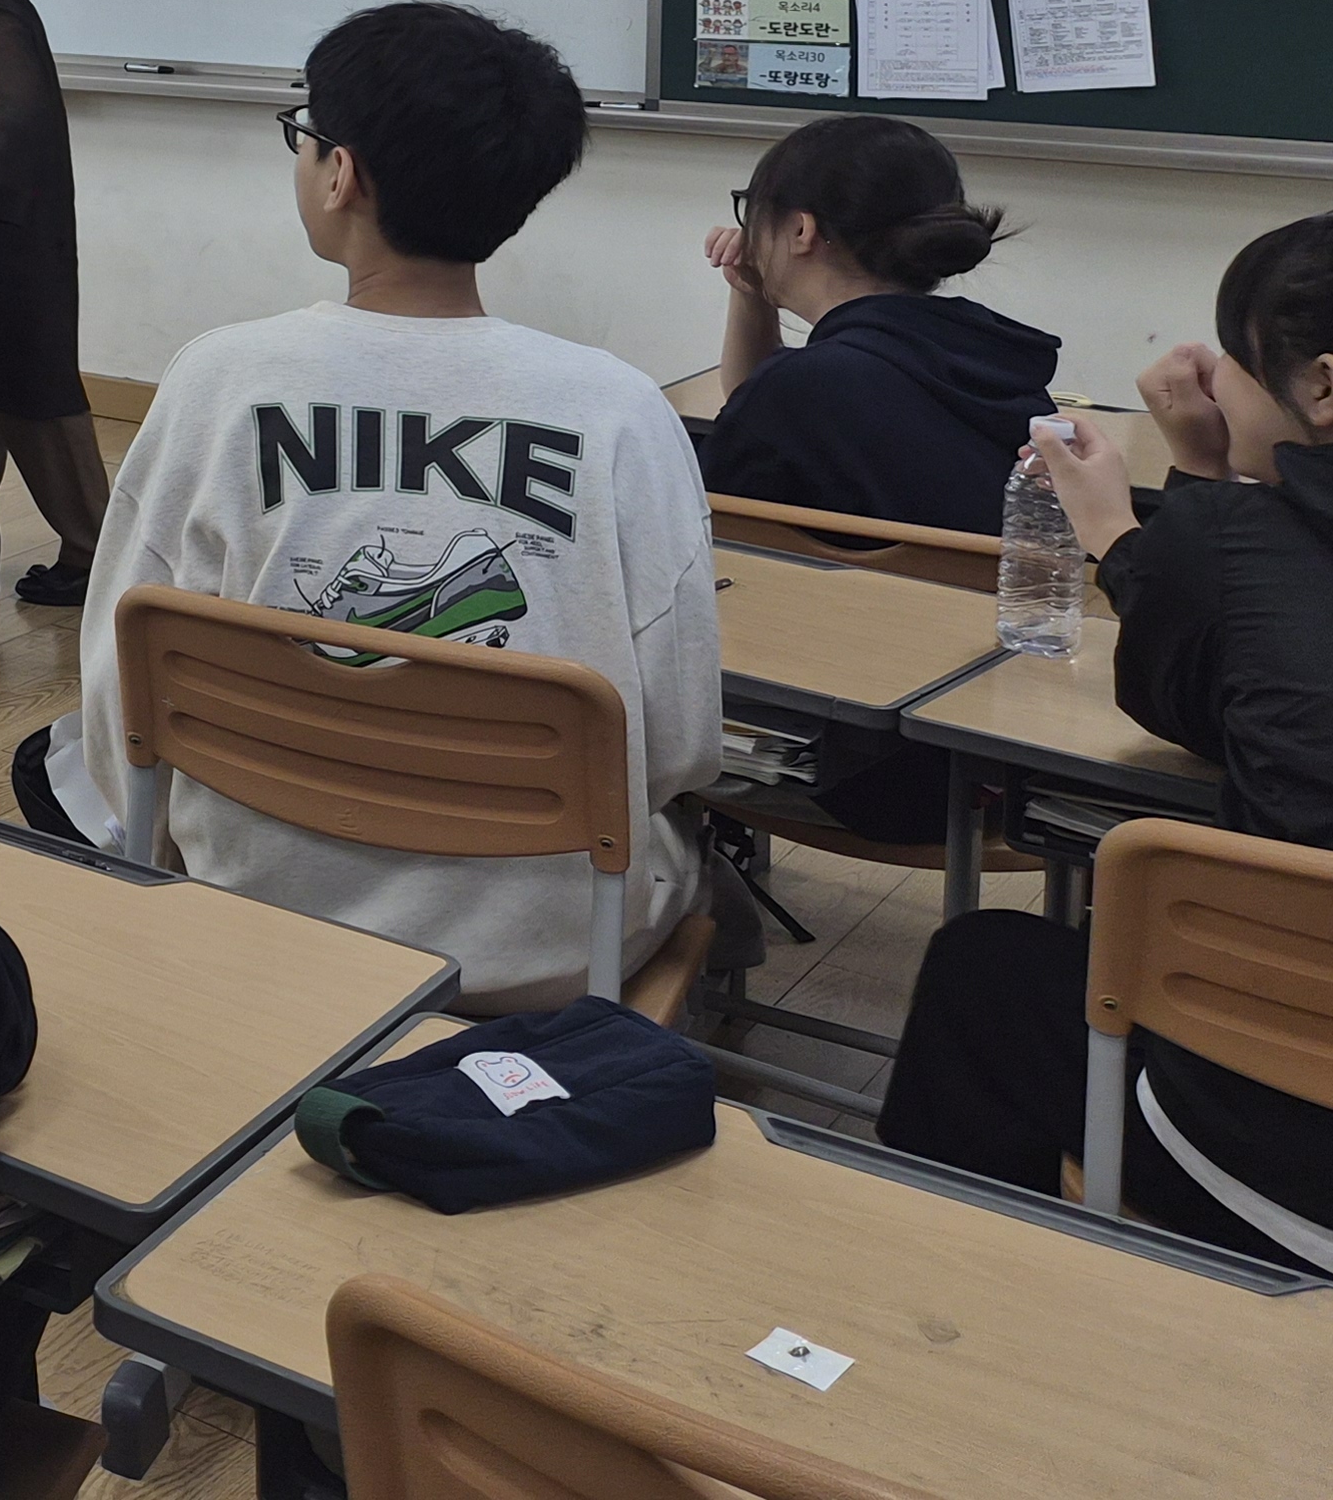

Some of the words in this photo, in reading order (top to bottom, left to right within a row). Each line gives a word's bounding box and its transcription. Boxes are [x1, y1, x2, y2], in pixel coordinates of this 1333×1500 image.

[777, 1, 821, 13] 목소리4
[759, 21, 840, 38] -도란도란-
[774, 49, 825, 63] 목소리30
[759, 70, 839, 88] -또랑또랑-
[252, 402, 584, 542] NIKE
